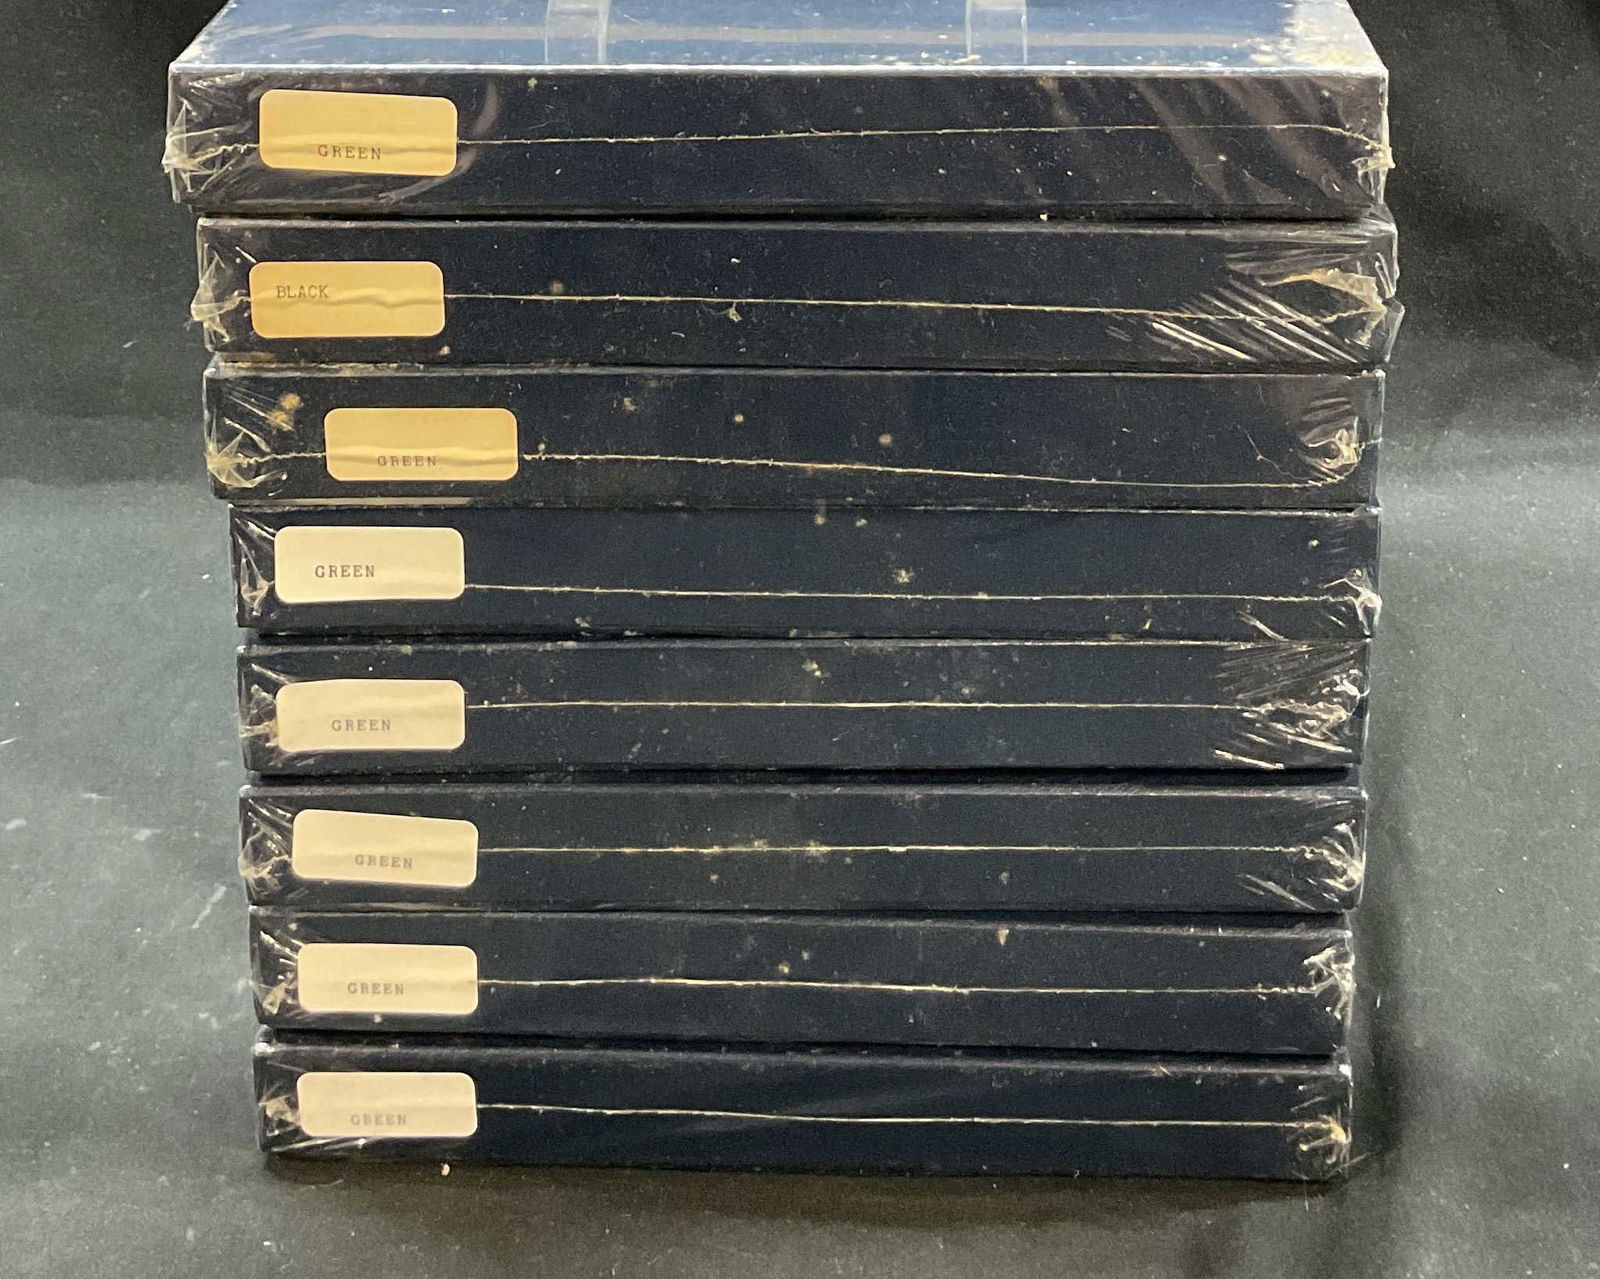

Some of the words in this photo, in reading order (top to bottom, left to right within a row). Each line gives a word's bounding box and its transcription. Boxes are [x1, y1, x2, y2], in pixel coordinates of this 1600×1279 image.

[317, 144, 382, 160] GREEN
[276, 285, 330, 299] BLACK
[377, 455, 437, 467] GREEN
[314, 565, 375, 578] GREEN
[331, 719, 391, 732] GREEN
[354, 854, 413, 869] GREEN
[347, 982, 405, 995] GREEN
[350, 1113, 407, 1126] GREEN
